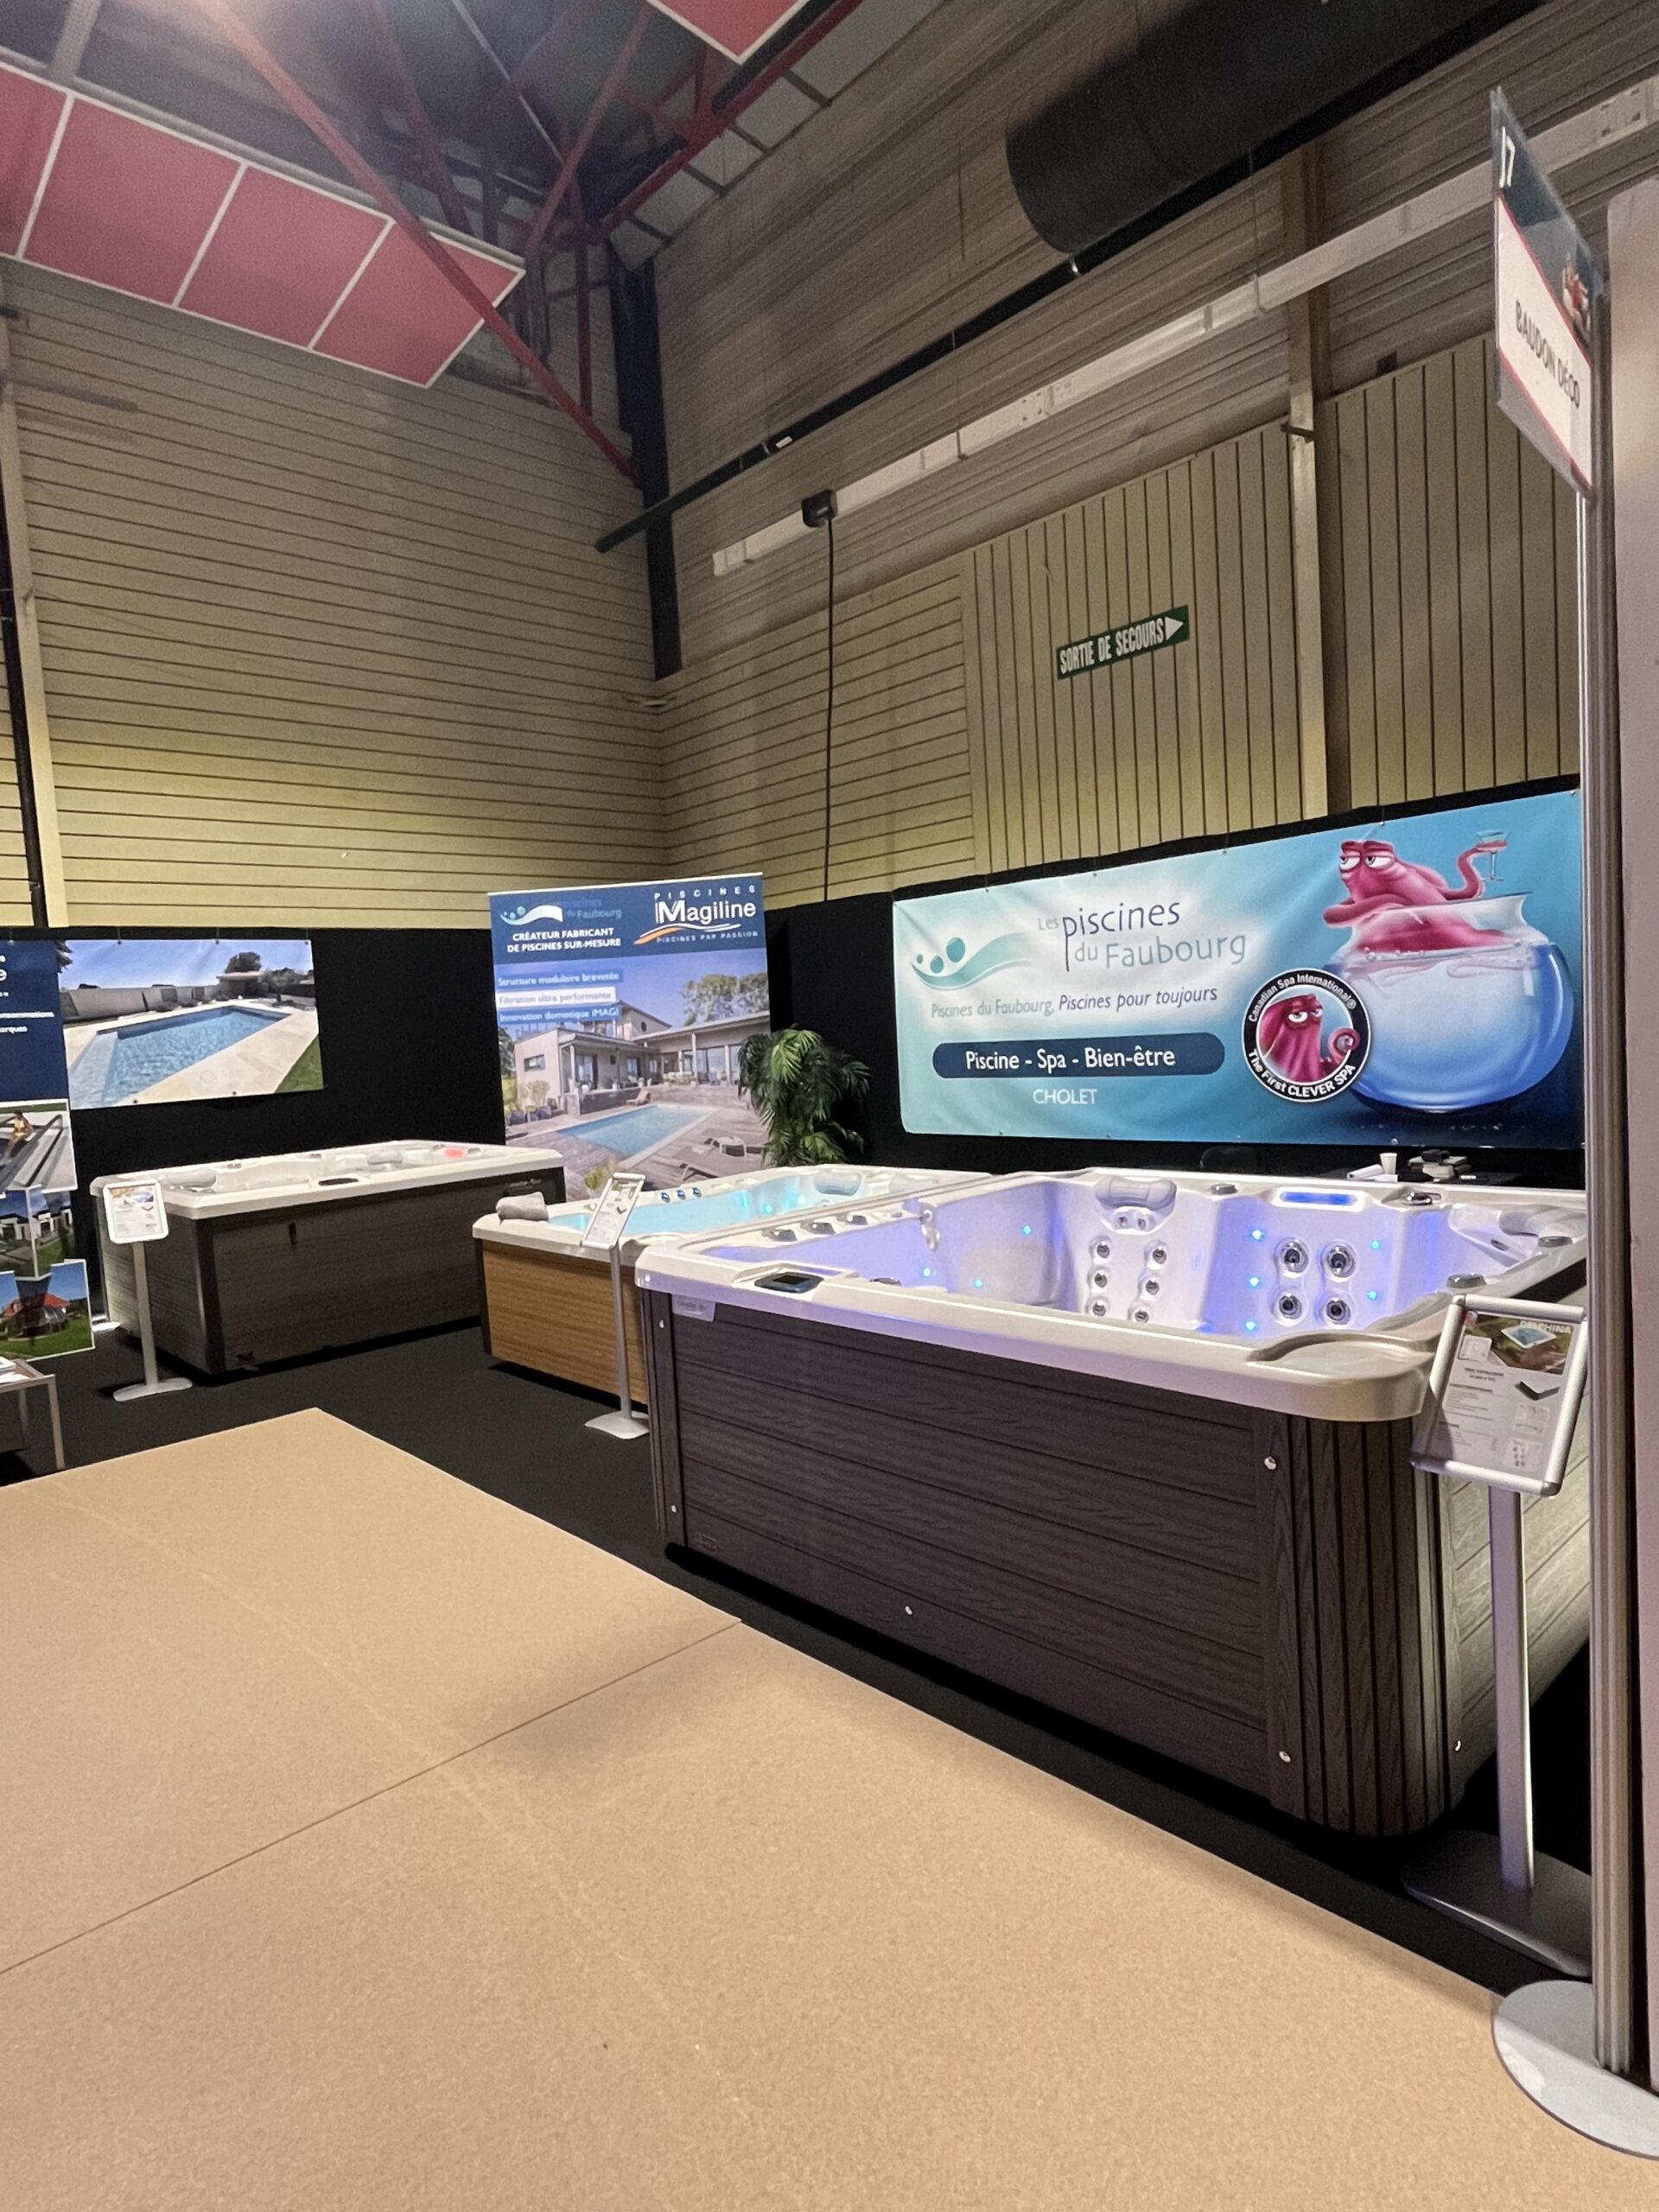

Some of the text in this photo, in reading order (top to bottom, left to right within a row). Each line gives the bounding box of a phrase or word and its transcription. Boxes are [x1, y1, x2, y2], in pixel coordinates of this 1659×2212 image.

[1516, 300, 1580, 408] BAUDON DÉCO
[1059, 618, 1164, 675] SORTIE DE SECOURS
[654, 885, 755, 899] PISCINES
[577, 909, 621, 918] Faubourg
[655, 899, 756, 925] Magiline
[512, 927, 614, 942] CRÉATEUR FABRICANT
[721, 931, 759, 939] PASSION
[1038, 902, 1180, 973] Les piscines
[507, 938, 621, 953] DE PISCINES SUR-MESURE
[1074, 934, 1246, 969] du Faubourg
[498, 971, 620, 986] Structure modulaire brevetée
[499, 996, 536, 1005] Filtration
[931, 987, 1218, 1019] Piscines du Faubourg, Piscines pour toujours
[1249, 985, 1278, 1022] Canadian
[1277, 976, 1295, 989] Spa
[499, 1012, 543, 1022] Innovation
[544, 1010, 589, 1020] domotique
[965, 1050, 1020, 1070] Piscine
[1037, 1048, 1067, 1074] Spa
[1084, 1045, 1176, 1069] Bien-être
[1249, 1048, 1357, 1097] The First CLEVER SPA
[1033, 1089, 1097, 1105] CHOLET
